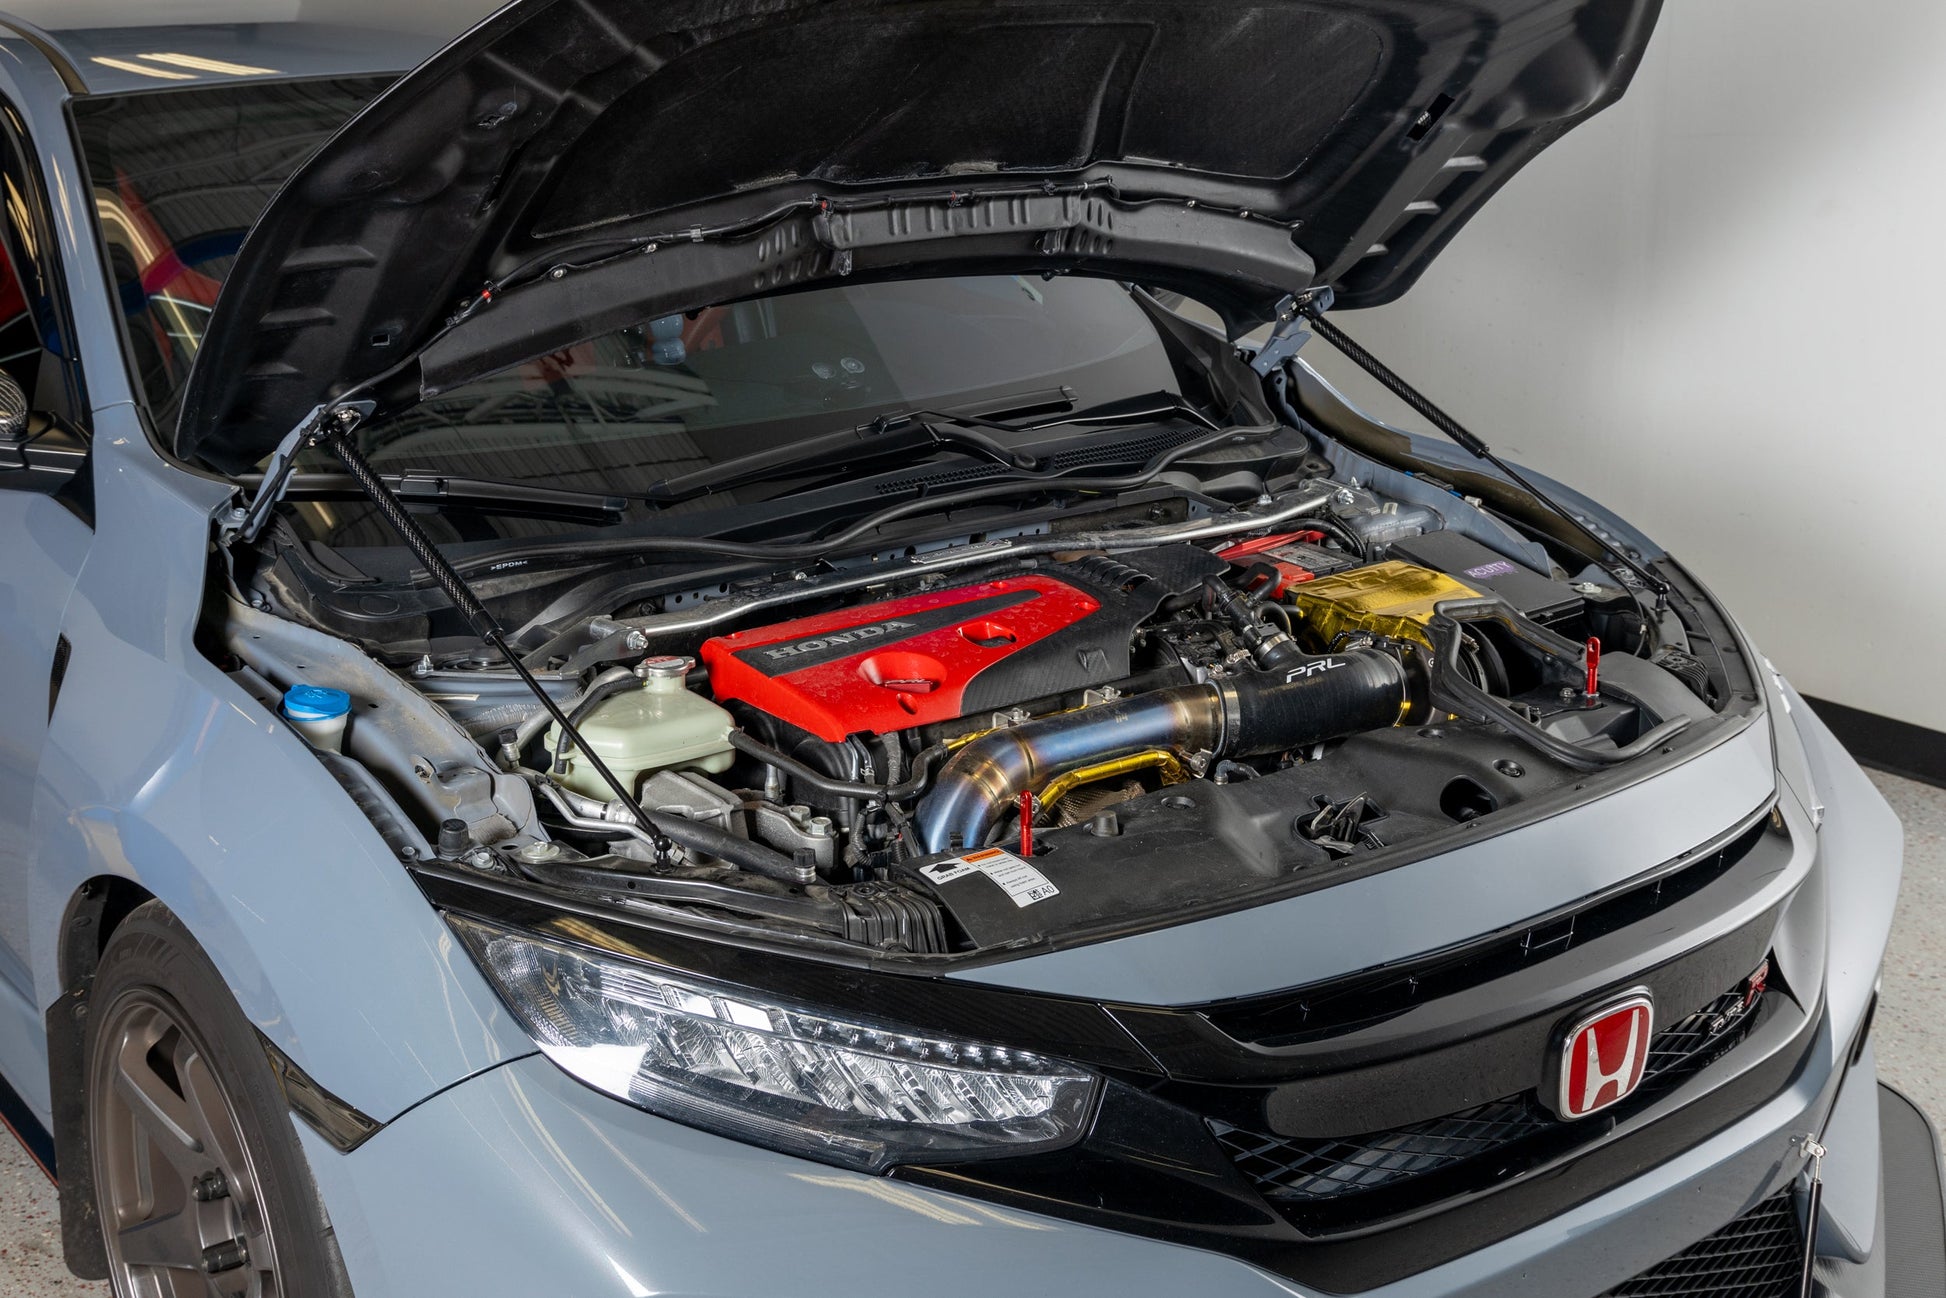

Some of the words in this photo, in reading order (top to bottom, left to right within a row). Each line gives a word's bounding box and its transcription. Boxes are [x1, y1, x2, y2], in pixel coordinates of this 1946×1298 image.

[1467, 561, 1510, 578] ACUITY
[763, 620, 917, 660] HONDA
[1286, 657, 1346, 684] PRL
[1743, 958, 1769, 1008] R
